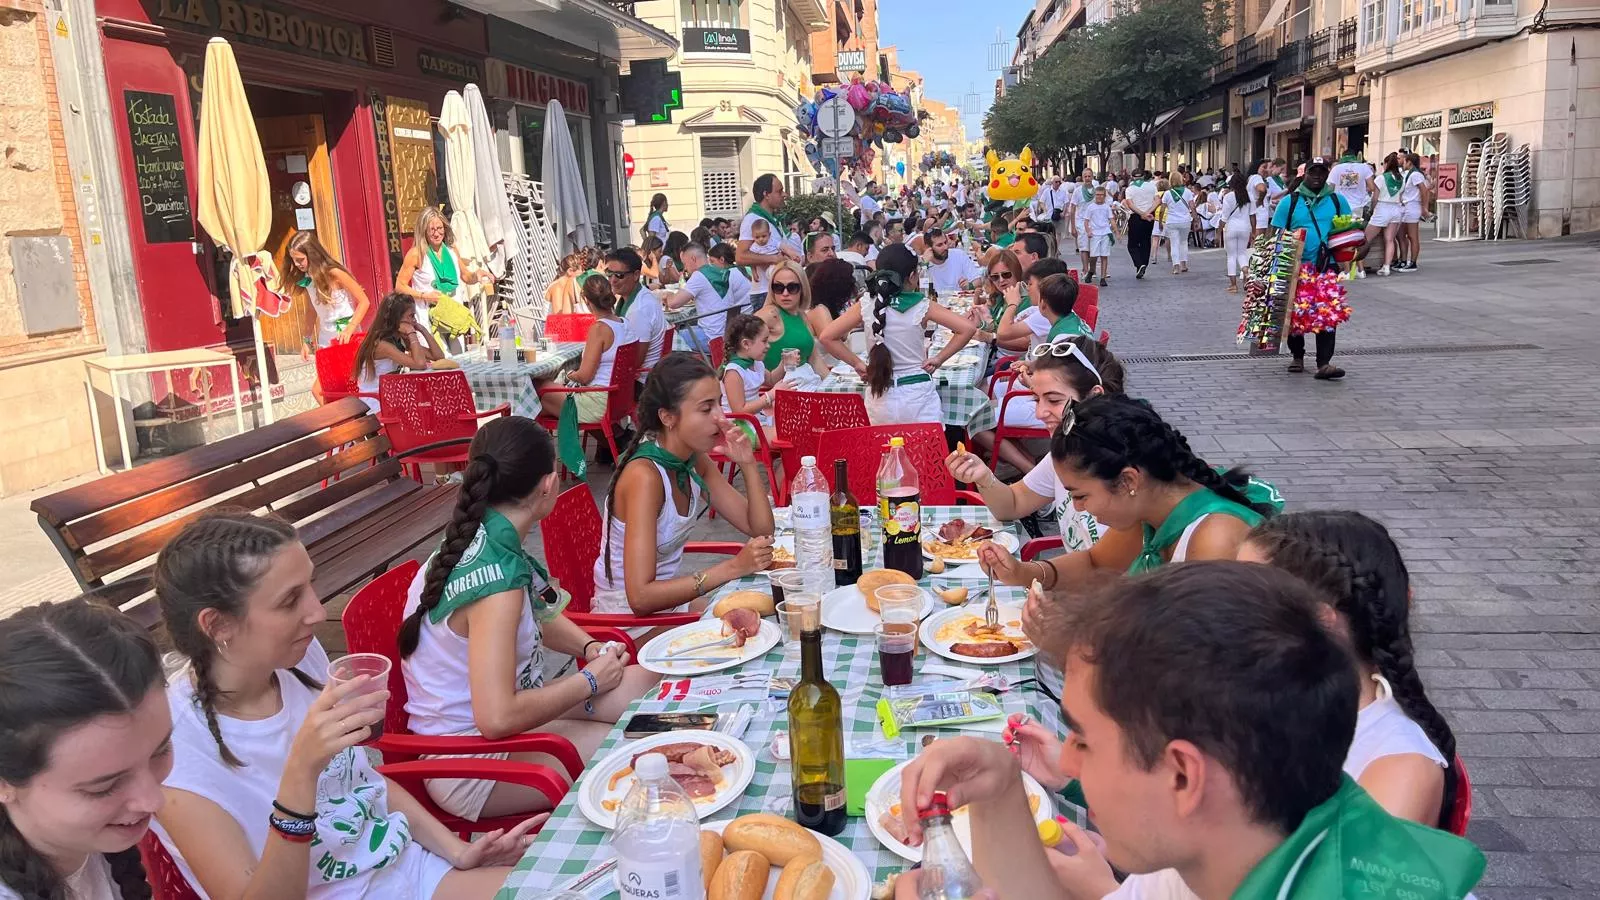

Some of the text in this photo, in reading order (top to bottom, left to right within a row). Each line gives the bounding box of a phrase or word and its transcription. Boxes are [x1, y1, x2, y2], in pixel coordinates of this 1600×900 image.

[158, 0, 368, 61] LA REBOTICA
[838, 52, 865, 65] DUVISA
[894, 535, 918, 545] Lemon
[444, 562, 505, 602] LAURENTINA
[316, 850, 358, 882] PEÑA
